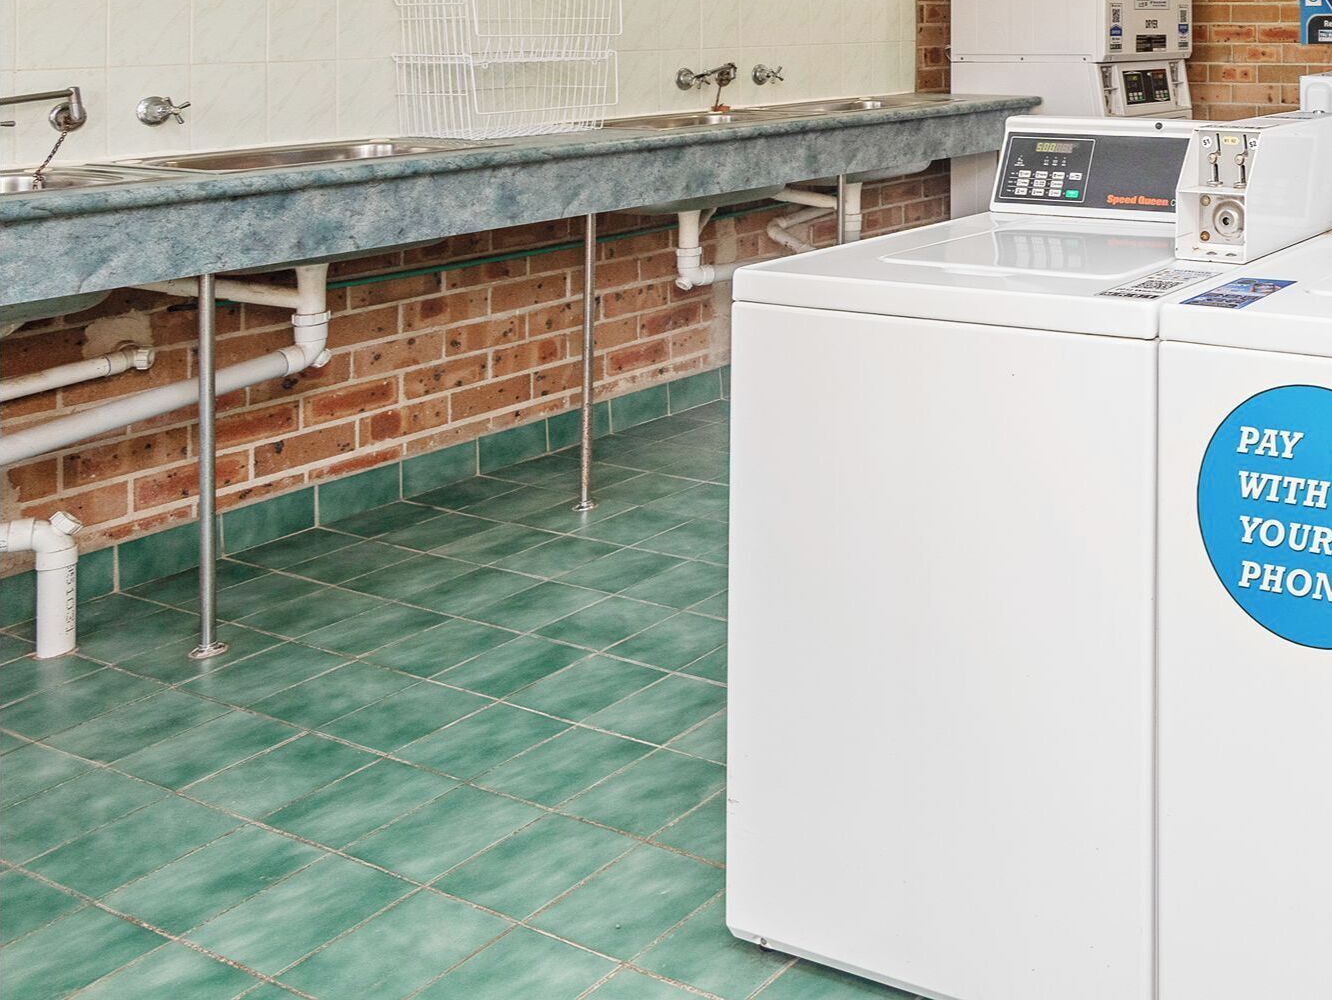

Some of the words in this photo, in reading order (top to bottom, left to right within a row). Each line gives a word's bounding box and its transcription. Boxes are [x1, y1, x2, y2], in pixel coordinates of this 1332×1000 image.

[1106, 194, 1137, 206] Speed
[1138, 195, 1169, 207] Queen
[1236, 425, 1304, 459] PAY
[1237, 470, 1332, 509] WITH
